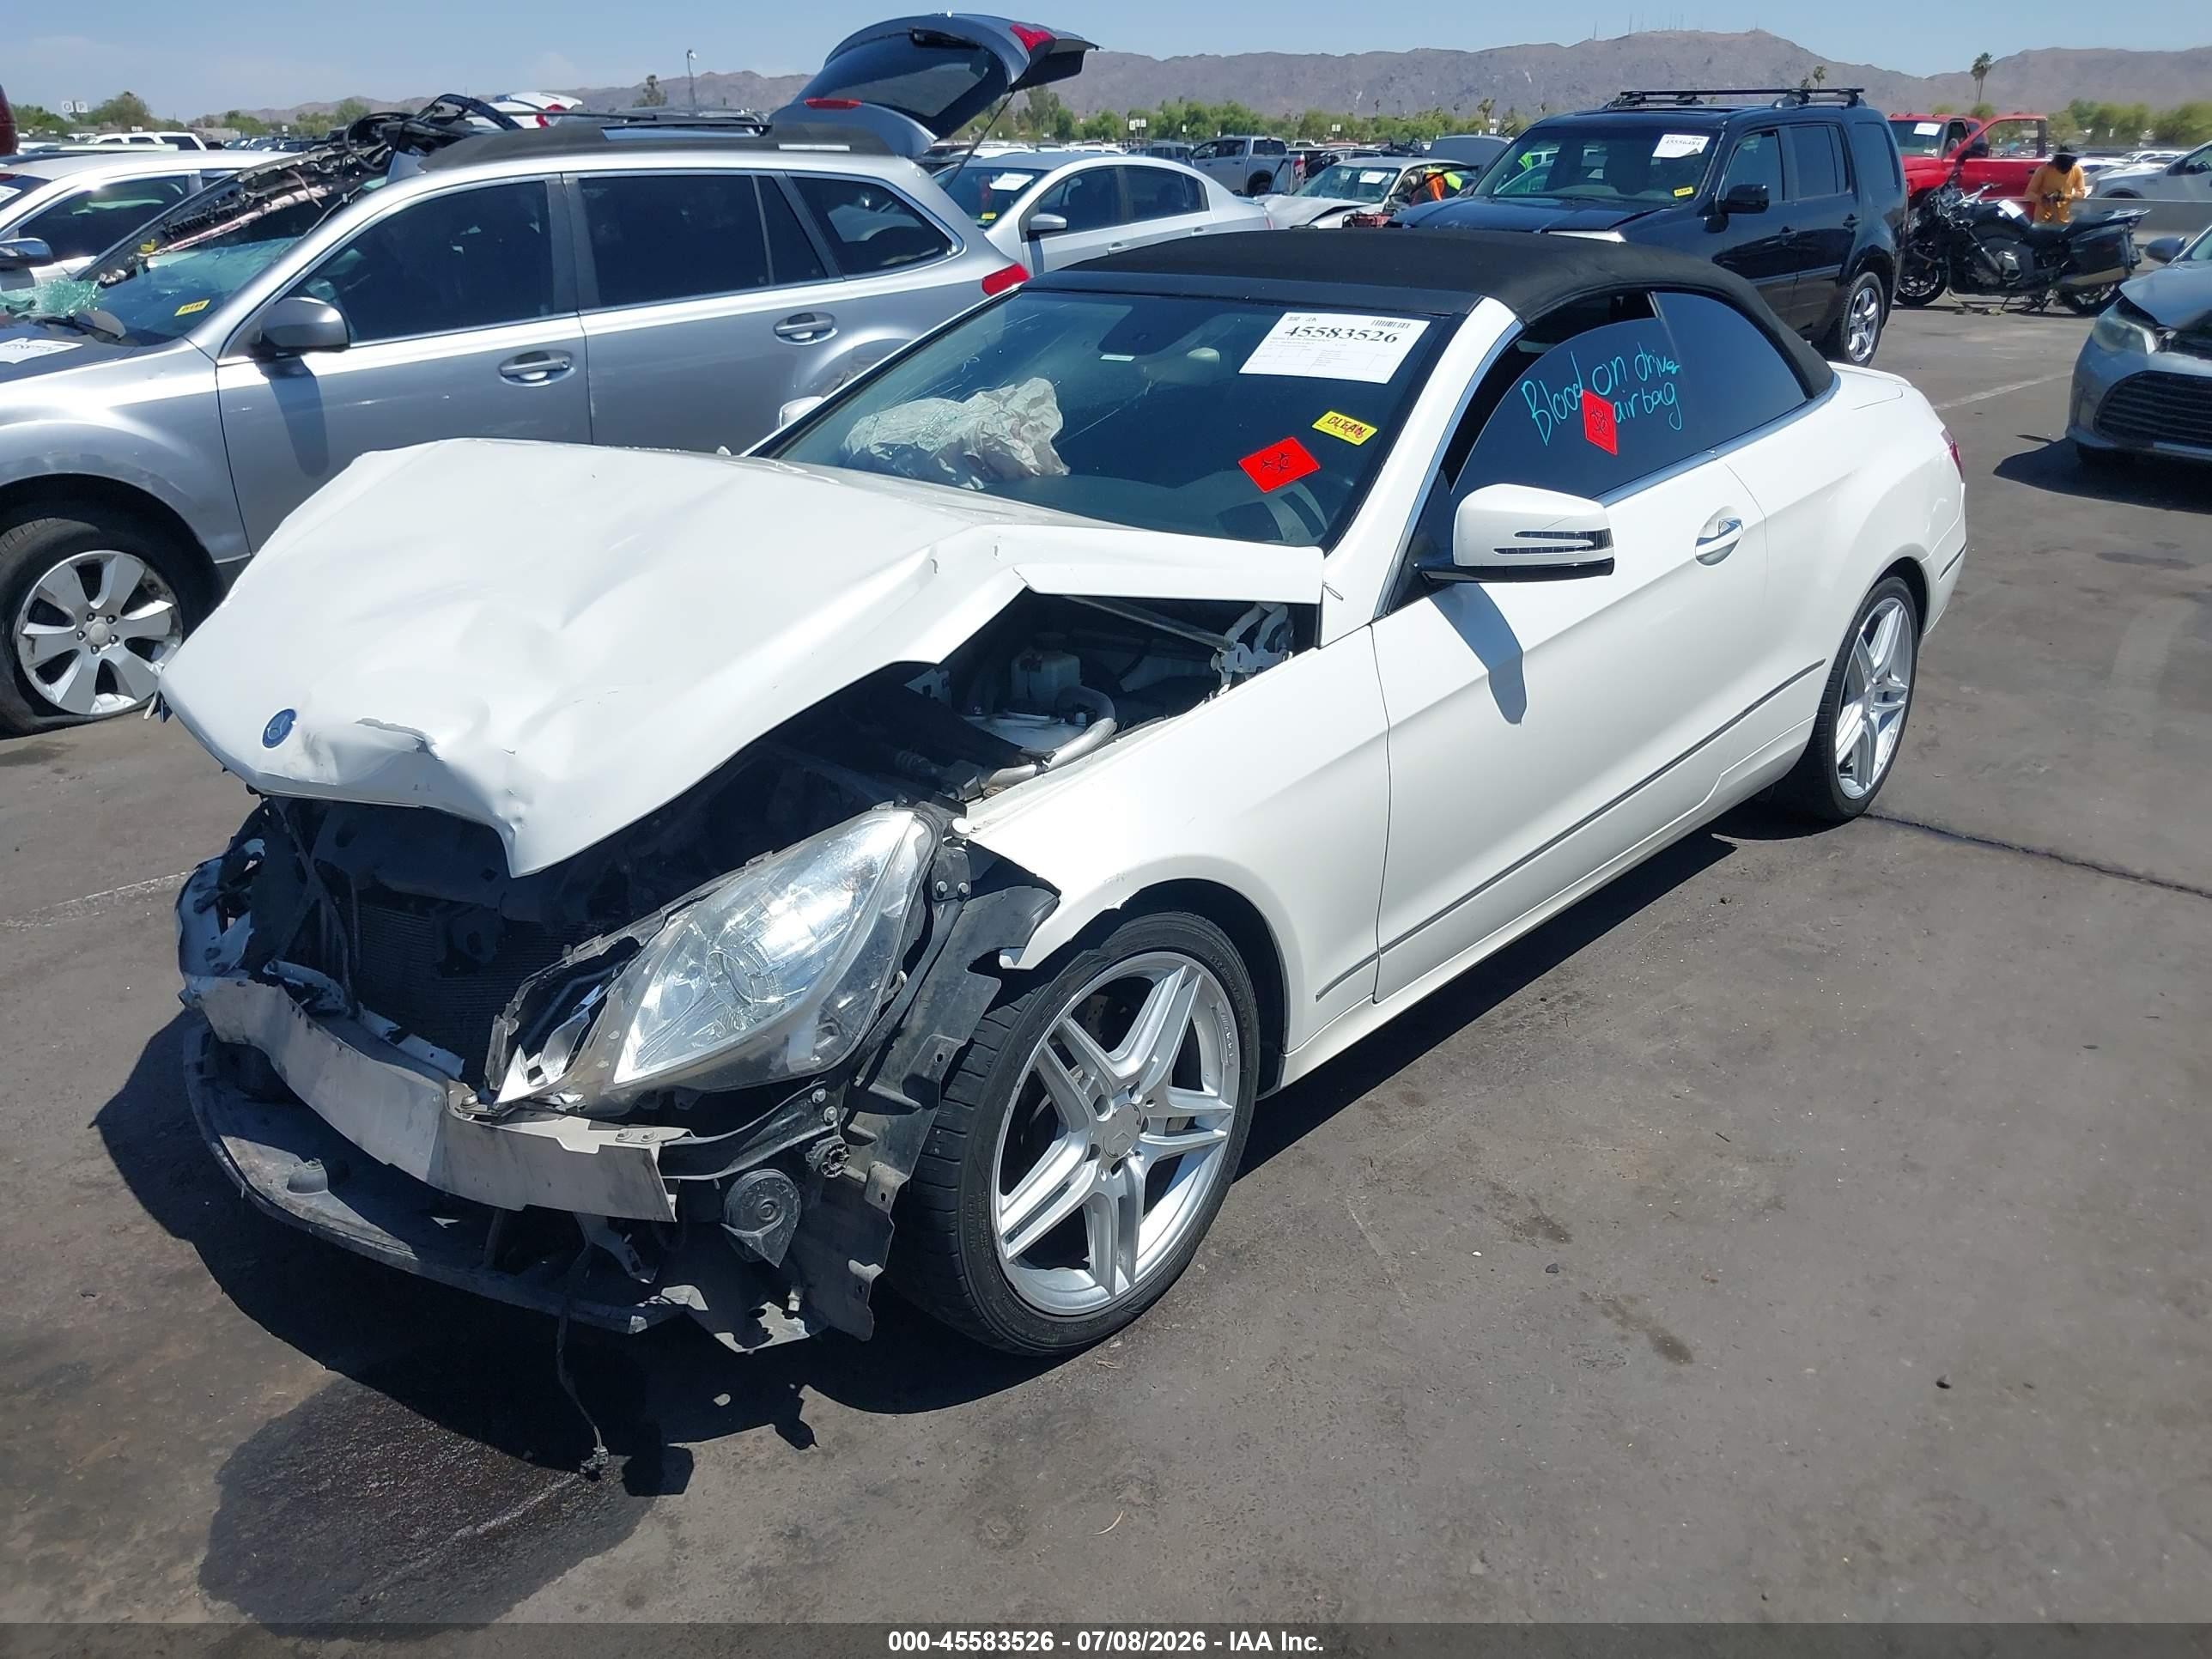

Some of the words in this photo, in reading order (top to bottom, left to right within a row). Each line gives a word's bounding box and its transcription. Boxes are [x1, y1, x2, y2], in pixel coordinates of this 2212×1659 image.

[1284, 325, 1401, 343] 45583526
[1521, 350, 1585, 447] Blood
[1327, 416, 1368, 435] CLEAN
